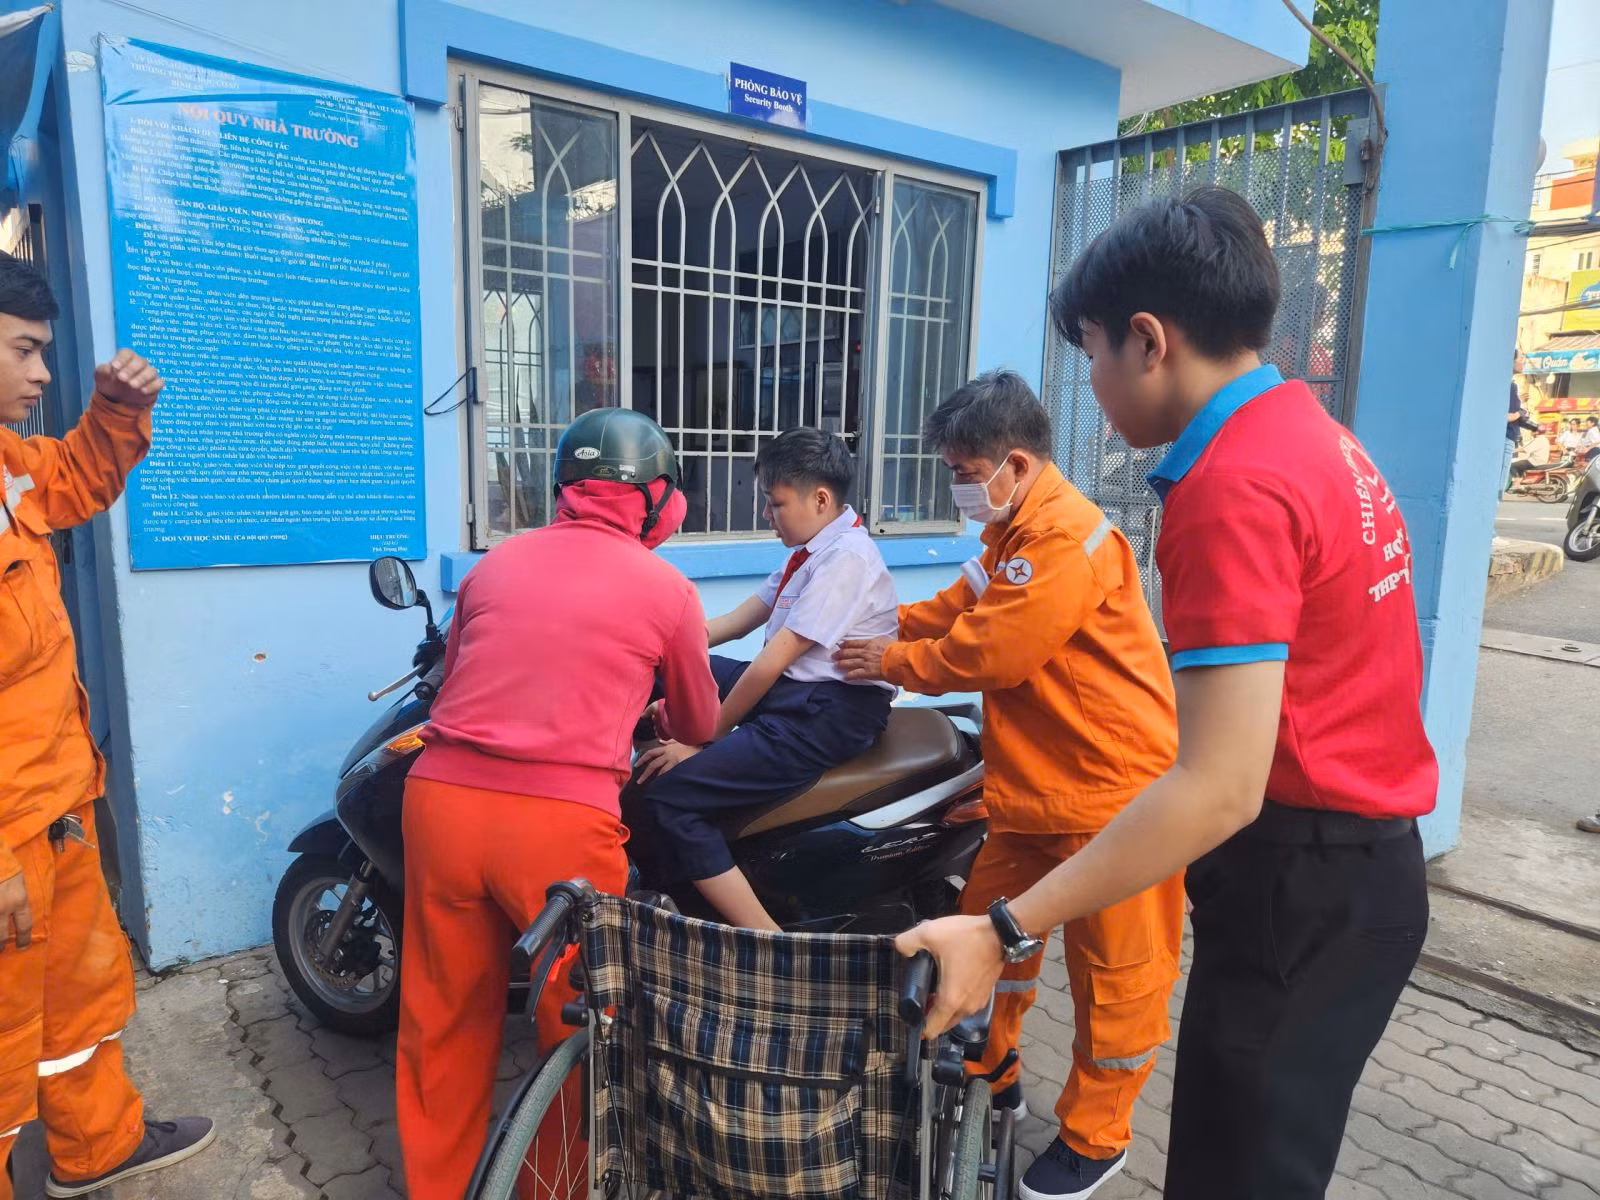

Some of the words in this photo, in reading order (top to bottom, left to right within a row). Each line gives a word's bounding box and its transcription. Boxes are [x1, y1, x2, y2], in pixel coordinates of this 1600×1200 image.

[734, 78, 768, 95] PHÒNG
[770, 86, 789, 101] BẢO
[790, 92, 803, 106] VỆ
[744, 94, 772, 109] Security
[774, 100, 793, 112] Booth
[214, 109, 250, 128] QUY
[253, 116, 288, 134] NHÀ
[291, 124, 358, 147] TRƯỜNG
[219, 132, 237, 141] LIÊN
[238, 135, 249, 144] HỆ
[250, 137, 272, 147] CÔNG
[274, 141, 290, 150] TÁC
[174, 198, 191, 207] CÁN
[192, 201, 206, 210] BỘ,
[207, 203, 227, 212] GIÁO
[229, 206, 249, 216] VIÊN,
[250, 209, 272, 218] NHÂN
[211, 222, 230, 231] THPT,
[164, 276, 182, 285] Trang
[1542, 355, 1569, 368] Quán
[578, 448, 596, 457] Asia
[1368, 567, 1410, 602] THPT
